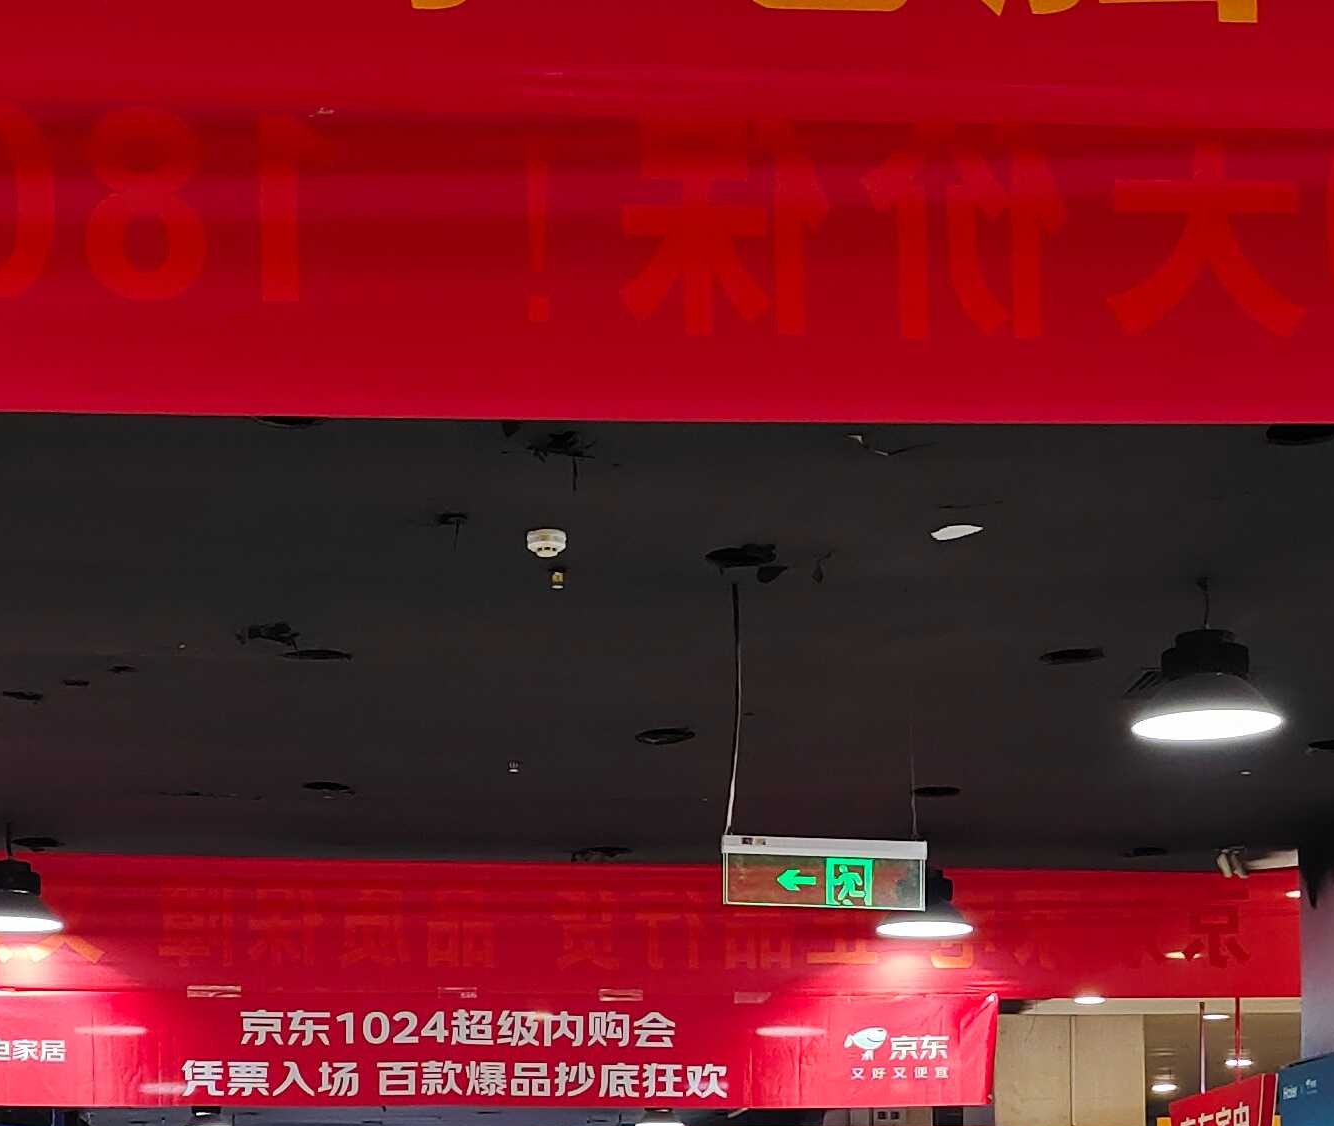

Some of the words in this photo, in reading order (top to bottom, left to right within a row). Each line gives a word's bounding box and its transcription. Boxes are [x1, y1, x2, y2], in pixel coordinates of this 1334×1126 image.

[239, 1008, 676, 1050] 京东1024超级内购会
[889, 1034, 949, 1061] 京东
[180, 1058, 360, 1099] 凭票入场
[377, 1059, 729, 1100] 百款爆品抄底狂欢
[849, 1065, 950, 1082] 又好又便宜
